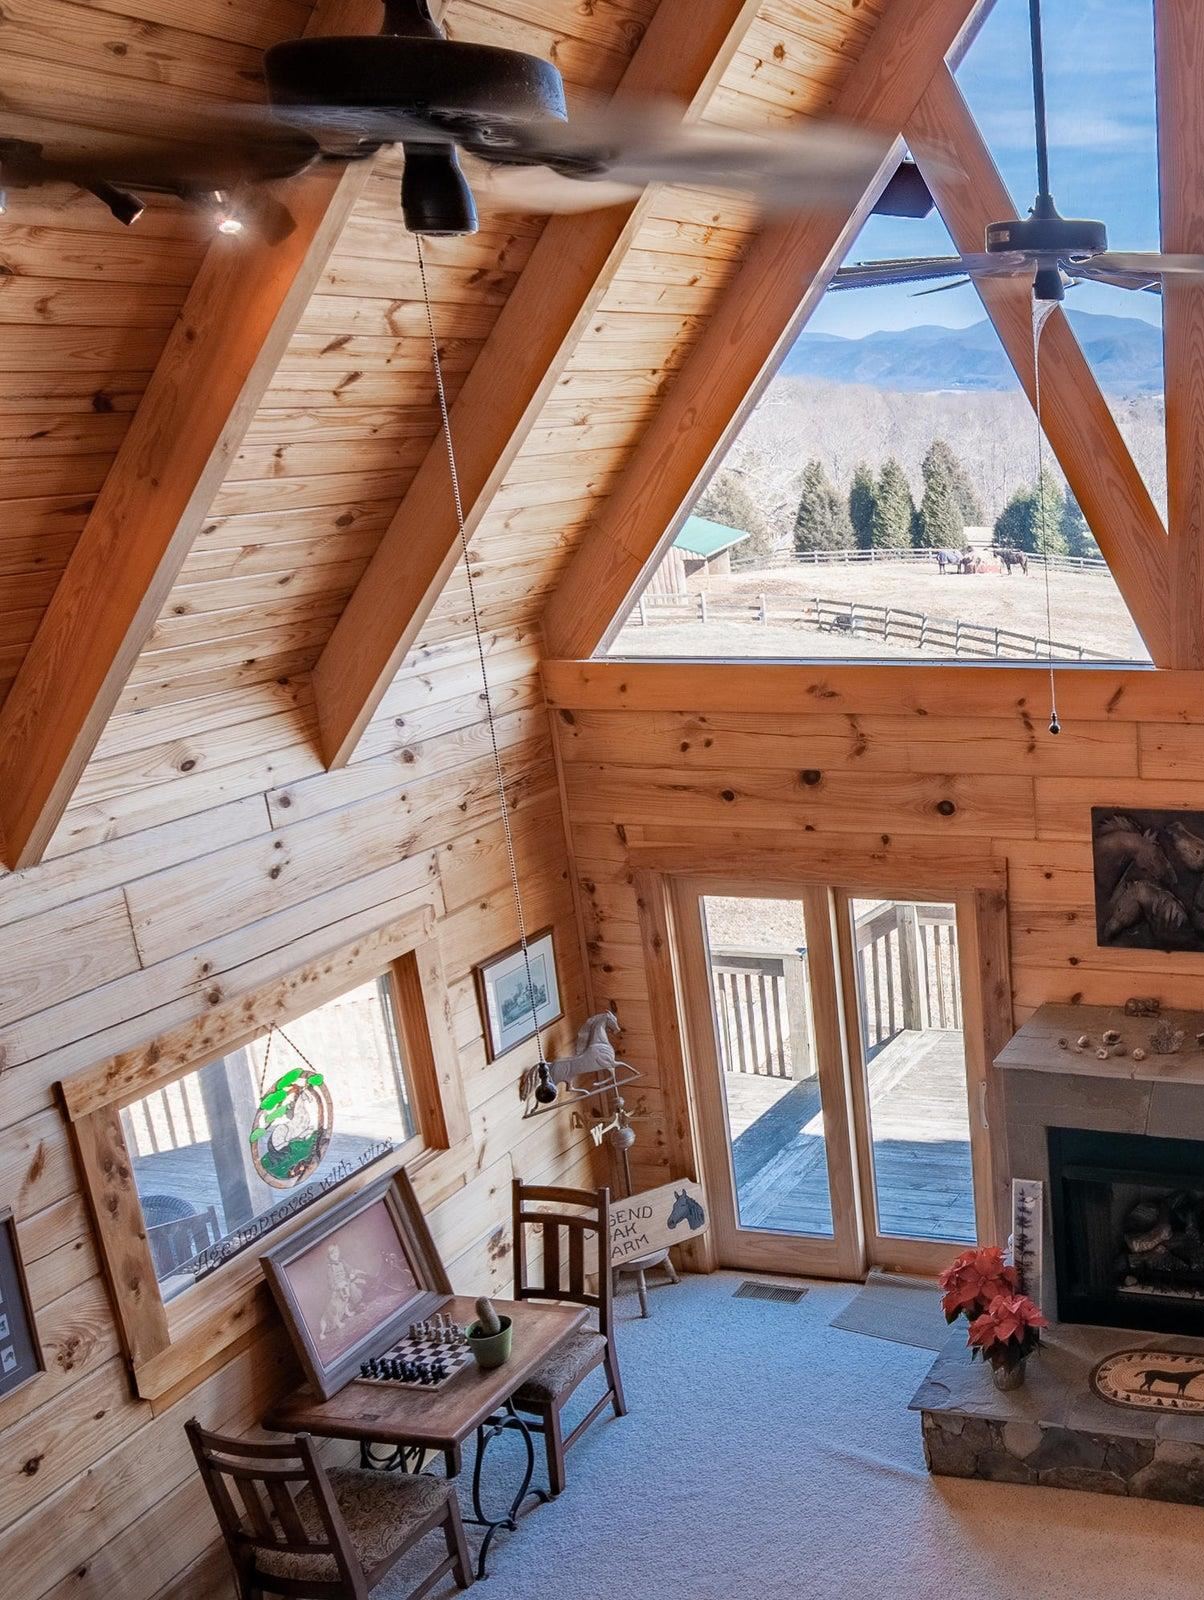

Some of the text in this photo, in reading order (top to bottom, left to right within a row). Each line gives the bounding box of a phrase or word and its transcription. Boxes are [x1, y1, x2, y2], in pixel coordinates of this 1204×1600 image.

[590, 1122, 604, 1147] W
[237, 1186, 314, 1243] improves
[320, 1160, 354, 1190] with
[358, 1137, 393, 1165] wine
[613, 1222, 637, 1242] AK
[611, 1234, 649, 1258] ARM
